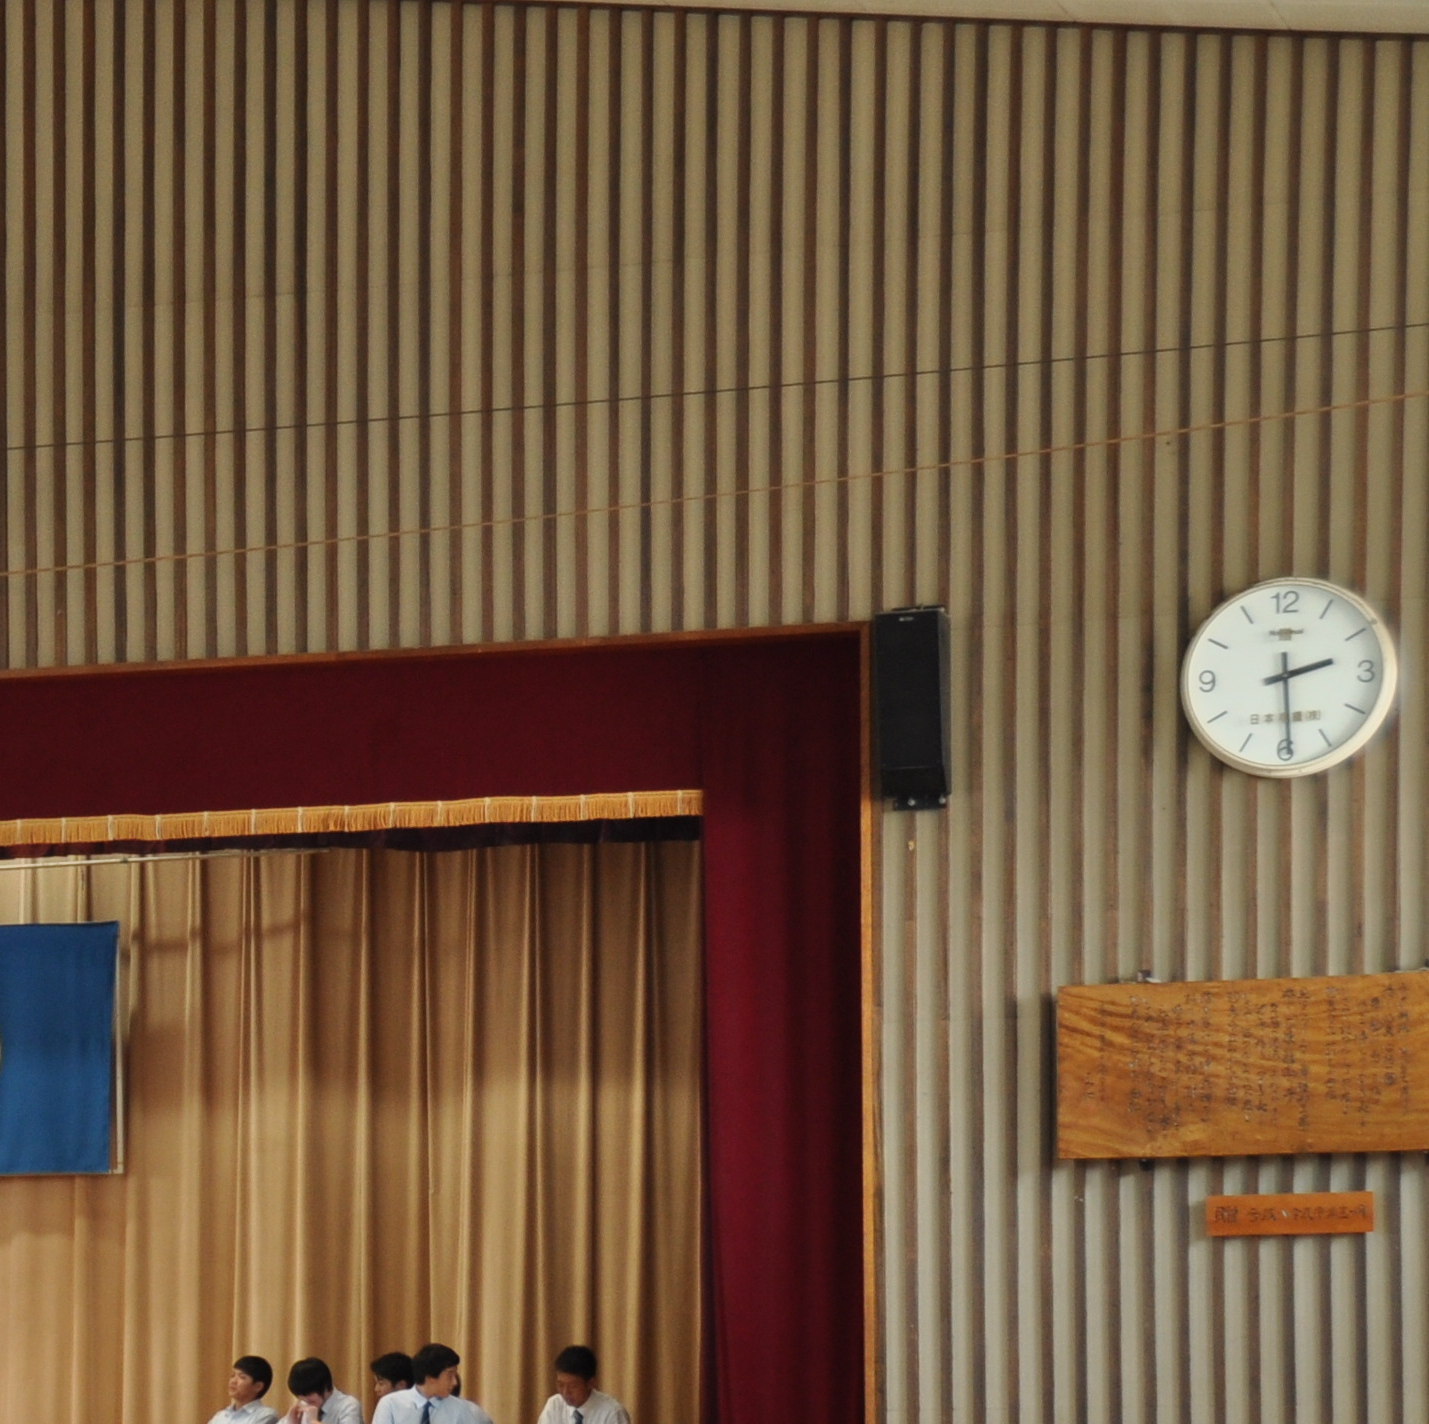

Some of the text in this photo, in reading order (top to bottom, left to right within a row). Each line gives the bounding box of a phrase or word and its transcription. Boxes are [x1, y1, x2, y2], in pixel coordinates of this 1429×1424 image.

[1270, 591, 1300, 614] 12
[1198, 670, 1216, 693] 9
[1357, 659, 1376, 682] 3
[1276, 738, 1295, 761] 6
